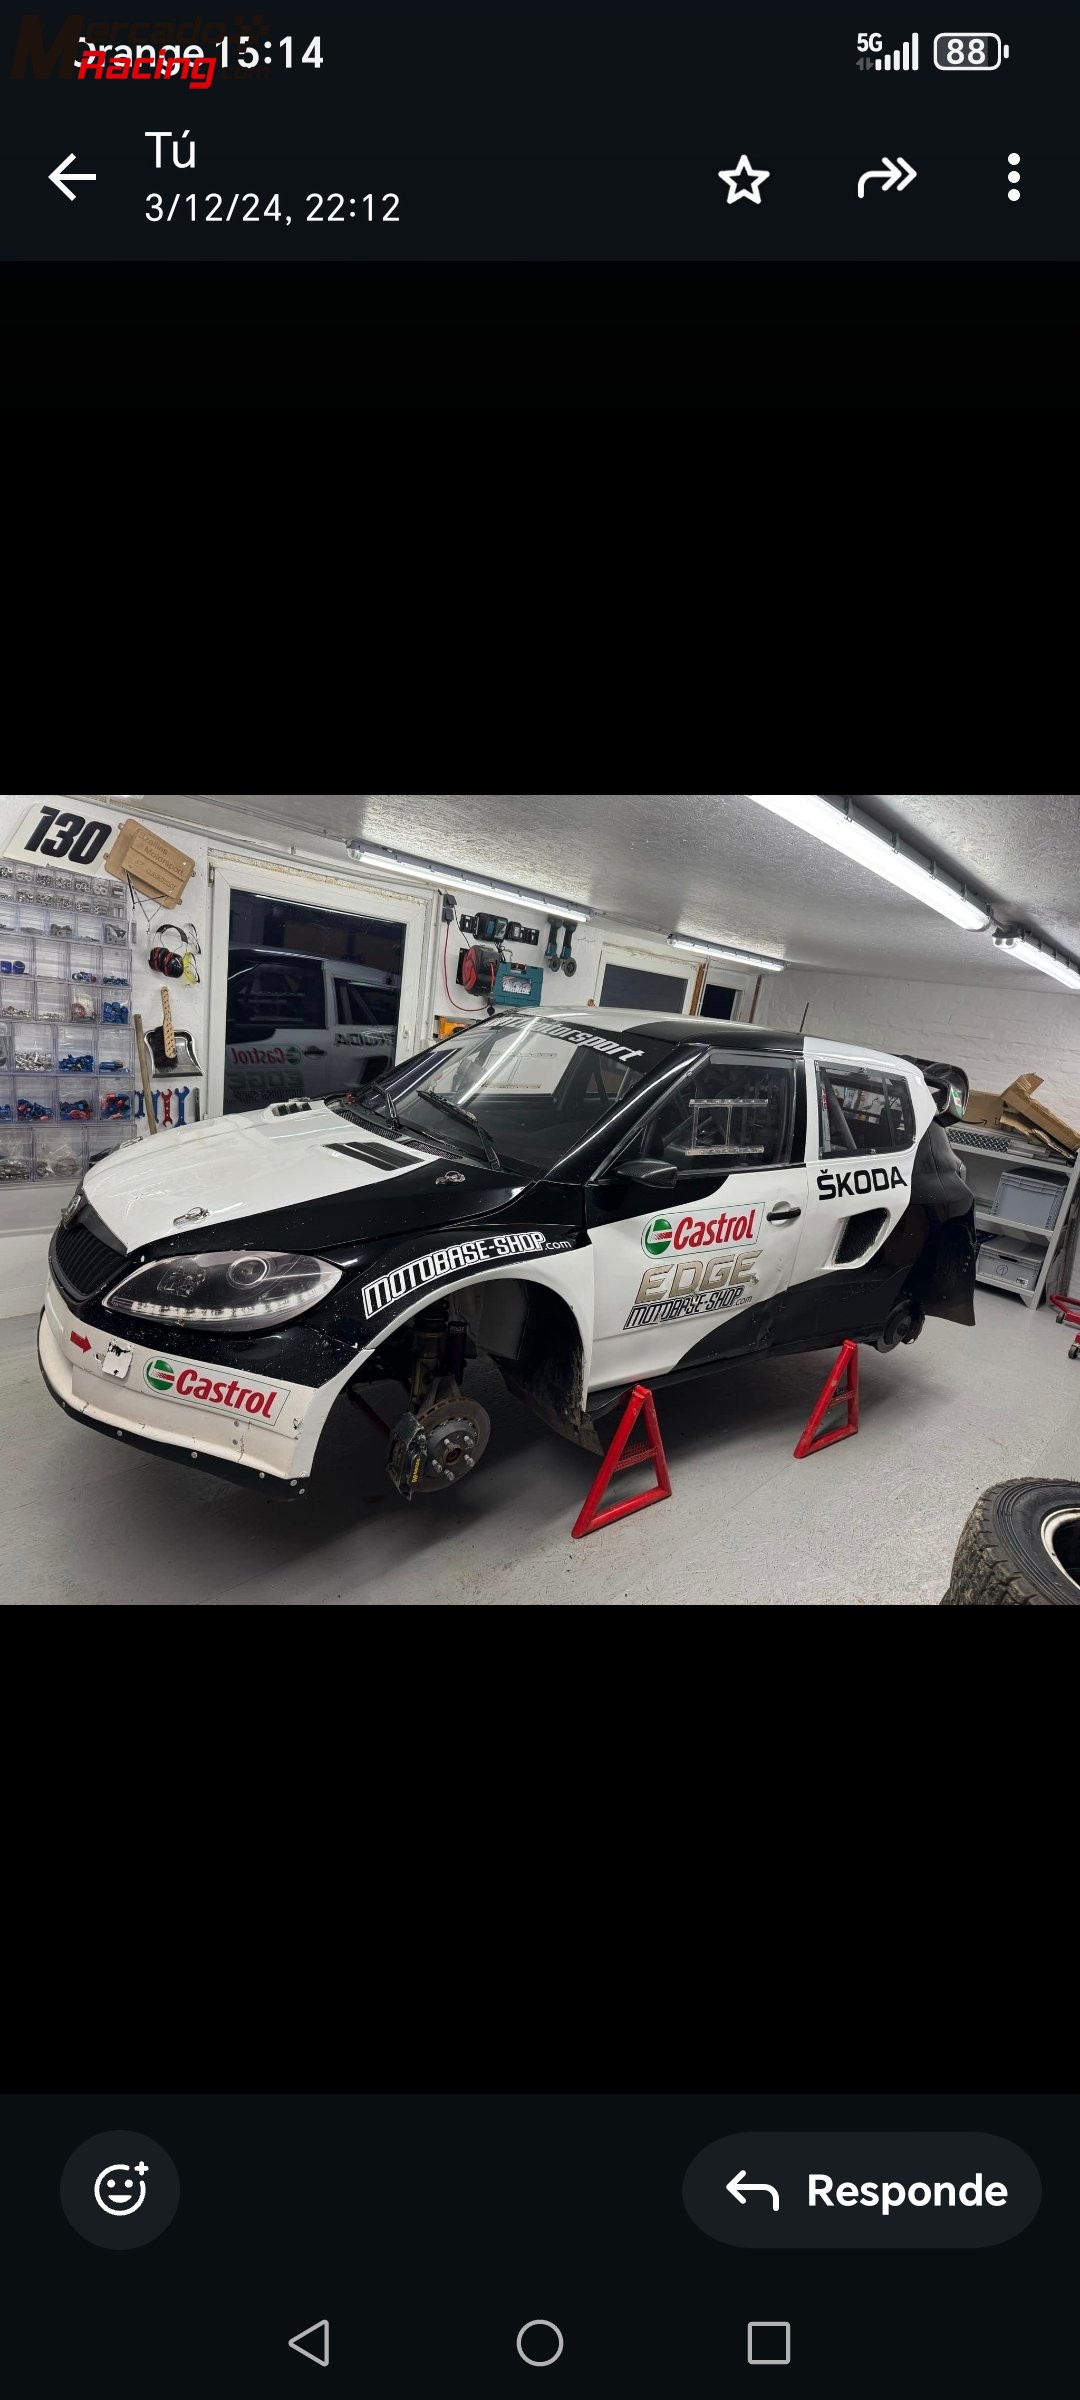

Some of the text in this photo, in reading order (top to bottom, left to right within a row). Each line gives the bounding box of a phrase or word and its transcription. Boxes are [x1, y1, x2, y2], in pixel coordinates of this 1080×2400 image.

[215, 35, 324, 68] 15:14
[857, 33, 883, 52] 5G
[946, 38, 986, 65] 88
[145, 130, 196, 169] Tú
[145, 193, 400, 226] 3/12/24, 22:12
[24, 805, 112, 865] 130
[817, 1166, 908, 1200] ŠKODA
[674, 1209, 756, 1250] Castrol
[635, 1250, 763, 1304] EDGE
[176, 1369, 277, 1419] Castrol
[807, 2172, 1009, 2214] Responde
